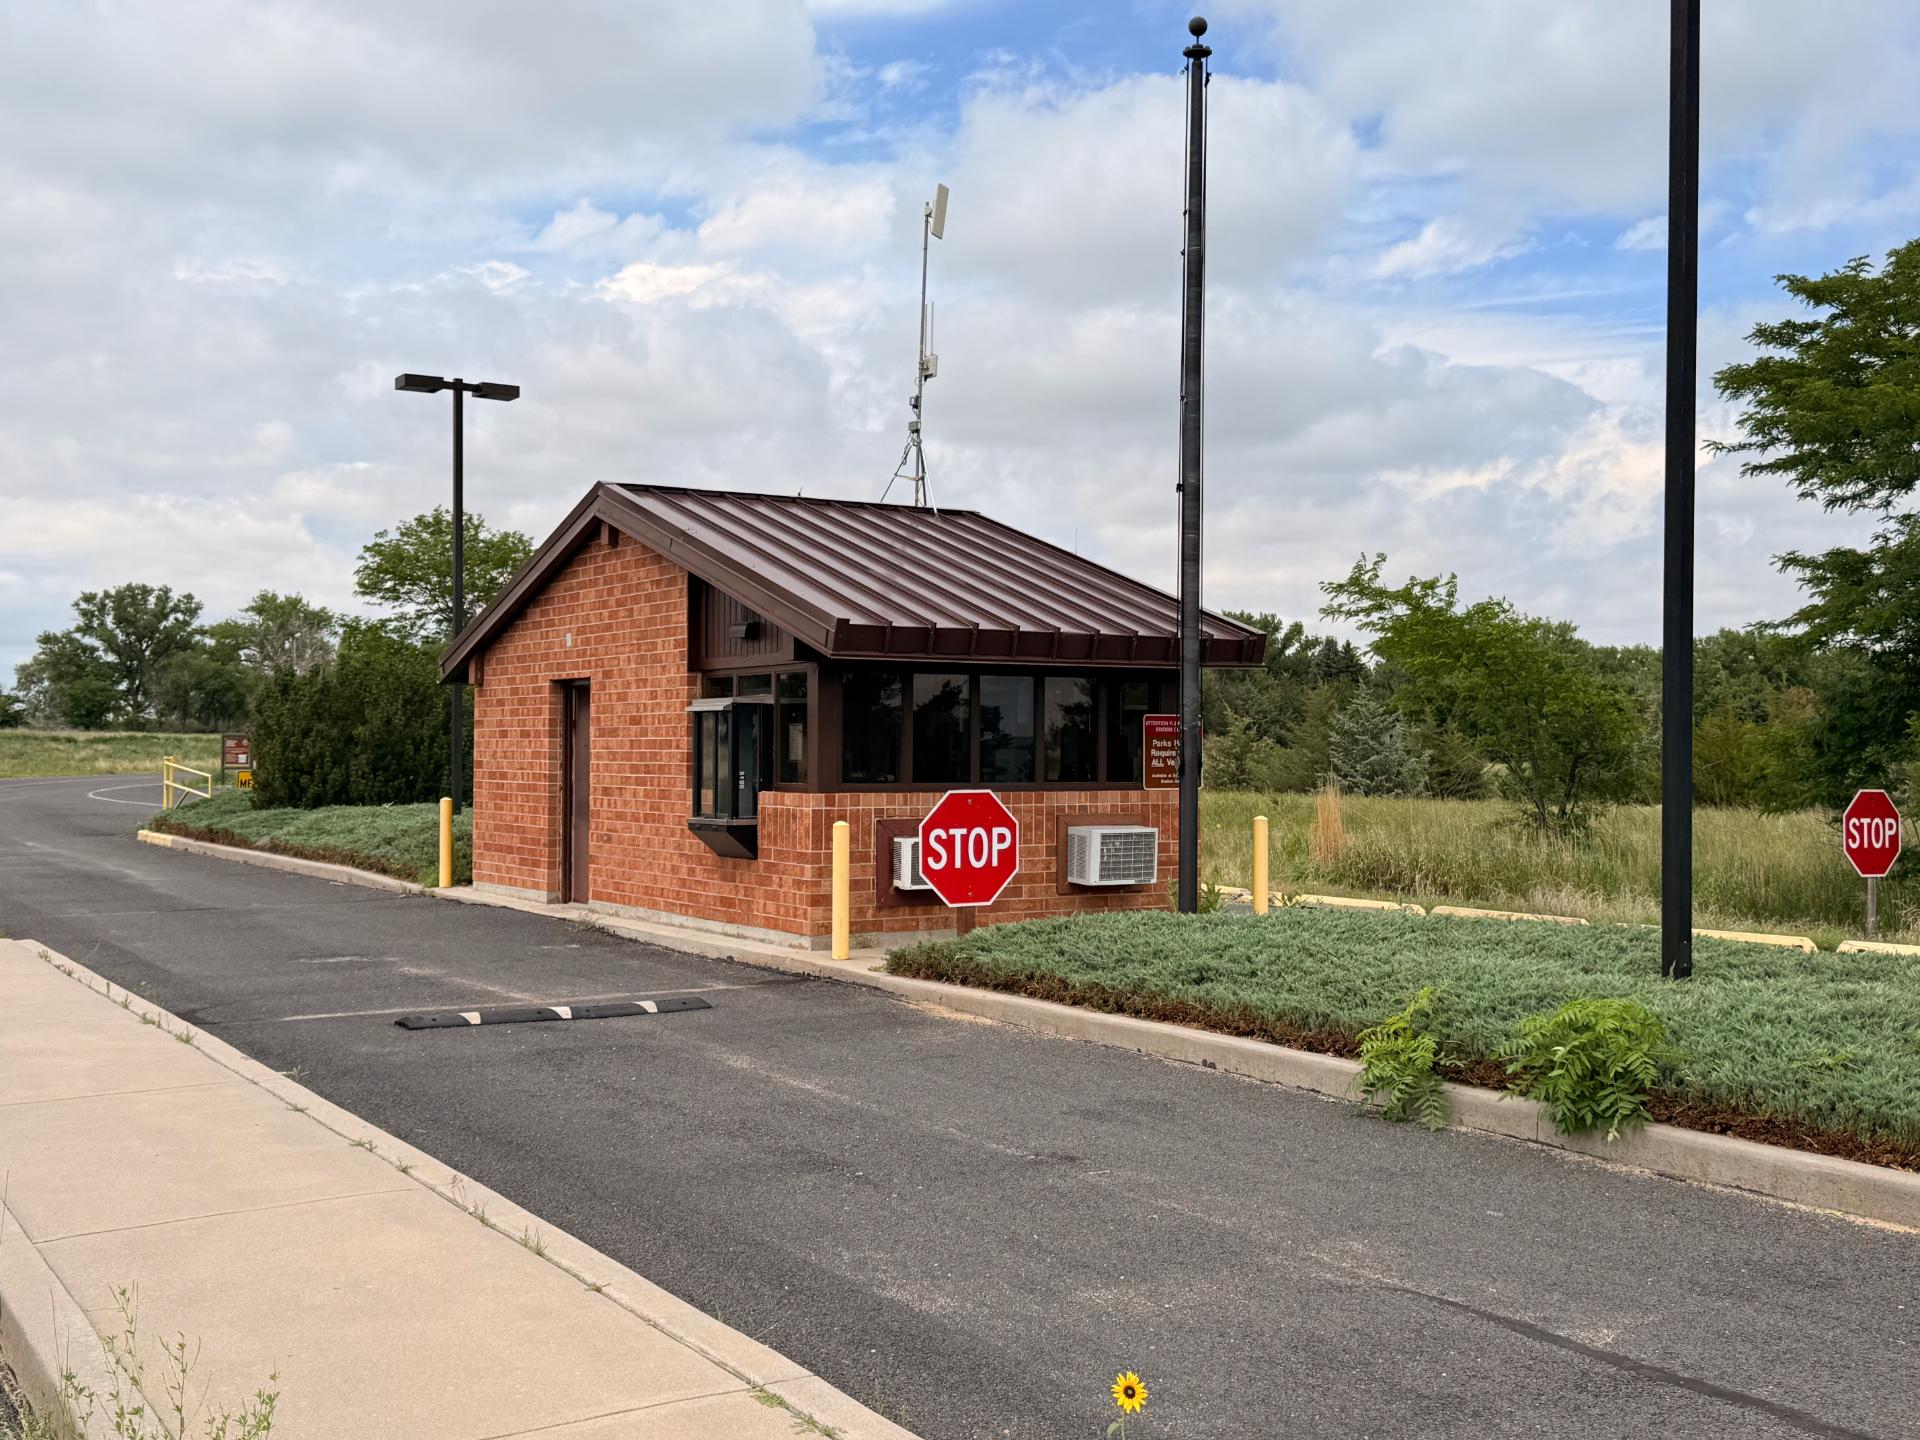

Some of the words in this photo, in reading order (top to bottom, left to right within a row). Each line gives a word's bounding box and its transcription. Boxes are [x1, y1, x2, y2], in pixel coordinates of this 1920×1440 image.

[1152, 739, 1172, 747] Parks
[1151, 749, 1179, 758] Require
[1848, 817, 1897, 849] STOP
[927, 826, 1012, 870] STOP
